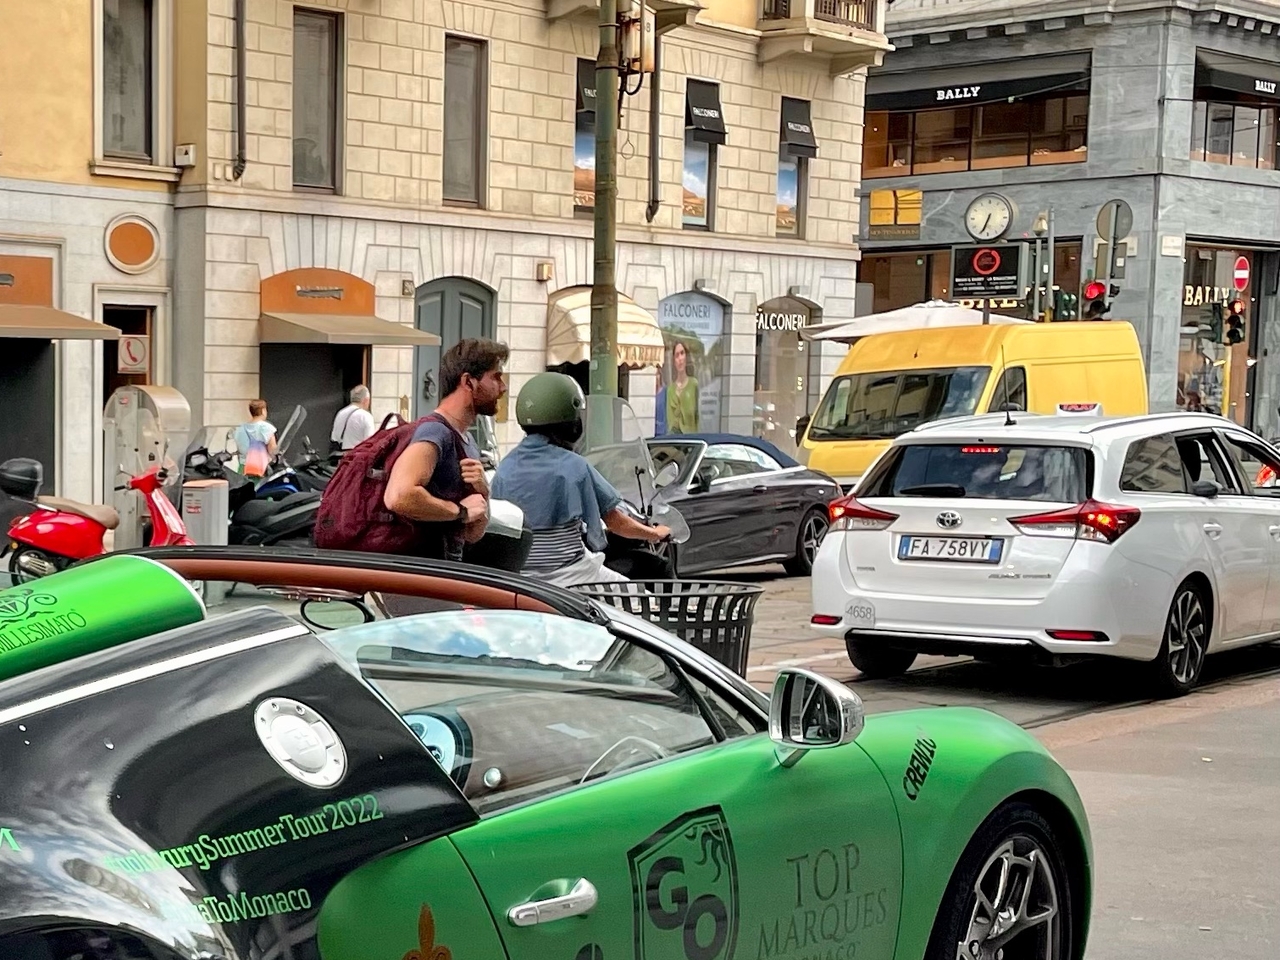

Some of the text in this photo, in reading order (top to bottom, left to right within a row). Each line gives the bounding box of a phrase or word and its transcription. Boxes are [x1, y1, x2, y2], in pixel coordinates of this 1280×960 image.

[936, 86, 980, 101] BALLY
[1255, 79, 1277, 94] BALLY
[1184, 285, 1230, 308] BALLY
[663, 303, 711, 319] FALCONERI
[910, 539, 989, 557] FA 758VY
[846, 605, 872, 620] 4658
[786, 843, 860, 908] TOP
[756, 888, 887, 960] MARQUES
